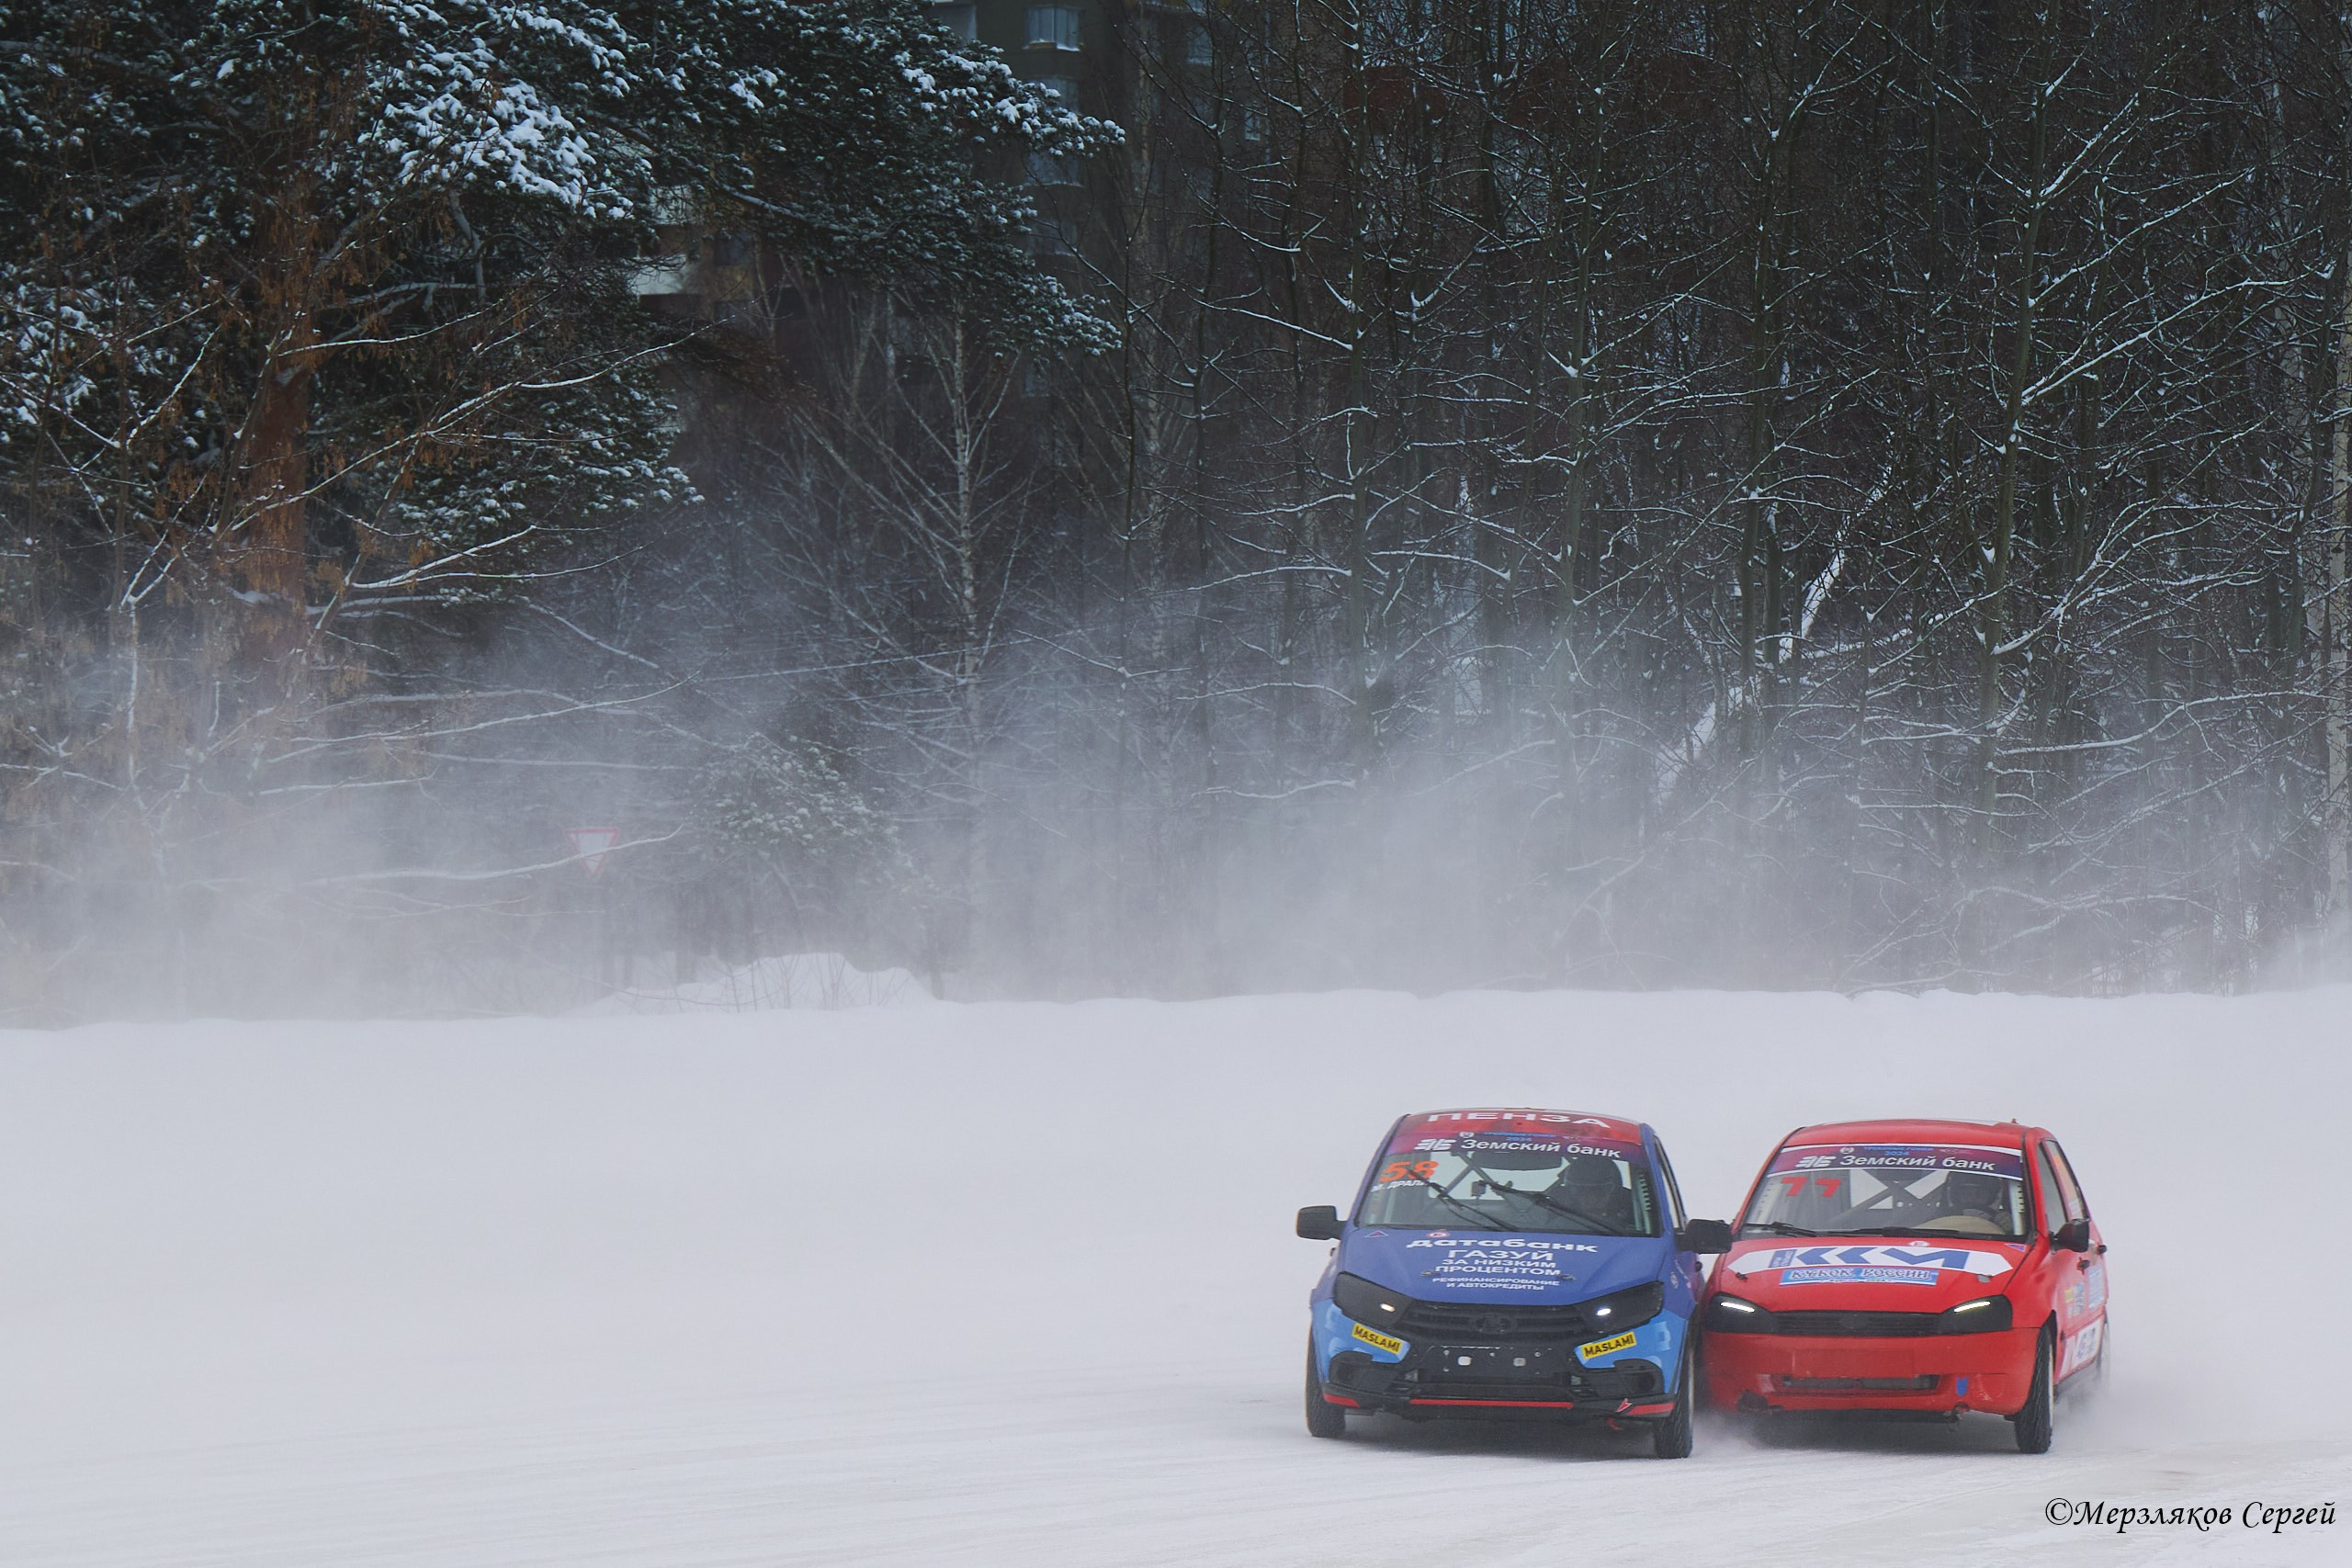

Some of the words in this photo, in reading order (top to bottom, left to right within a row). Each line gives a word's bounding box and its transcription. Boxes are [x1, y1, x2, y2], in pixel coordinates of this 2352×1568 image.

[1428, 1111, 1611, 1128] ПЕНЗА
[1461, 1138, 1560, 1153] Земский
[1567, 1144, 1622, 1159] банк
[1839, 1155, 1937, 1168] Земский
[1942, 1156, 1996, 1171] банк
[1378, 1160, 1440, 1182] 58
[1781, 1177, 1842, 1199] 77
[1406, 1238, 1599, 1253] датабанк
[1448, 1249, 1555, 1261] ГАЗУЙ
[1435, 1266, 1561, 1276] ПРОЦЕНТОМ
[1474, 1259, 1556, 1268] НИЗКИМ
[1861, 1268, 1930, 1280] РОССИИ
[1432, 1278, 1560, 1286] РЕФИНАНСИРОВАНИЕ
[1457, 1282, 1544, 1291] АВТОКРЕДИТЫ
[1353, 1325, 1402, 1354] MASLAMI
[1583, 1334, 1635, 1358] MASLAMI
